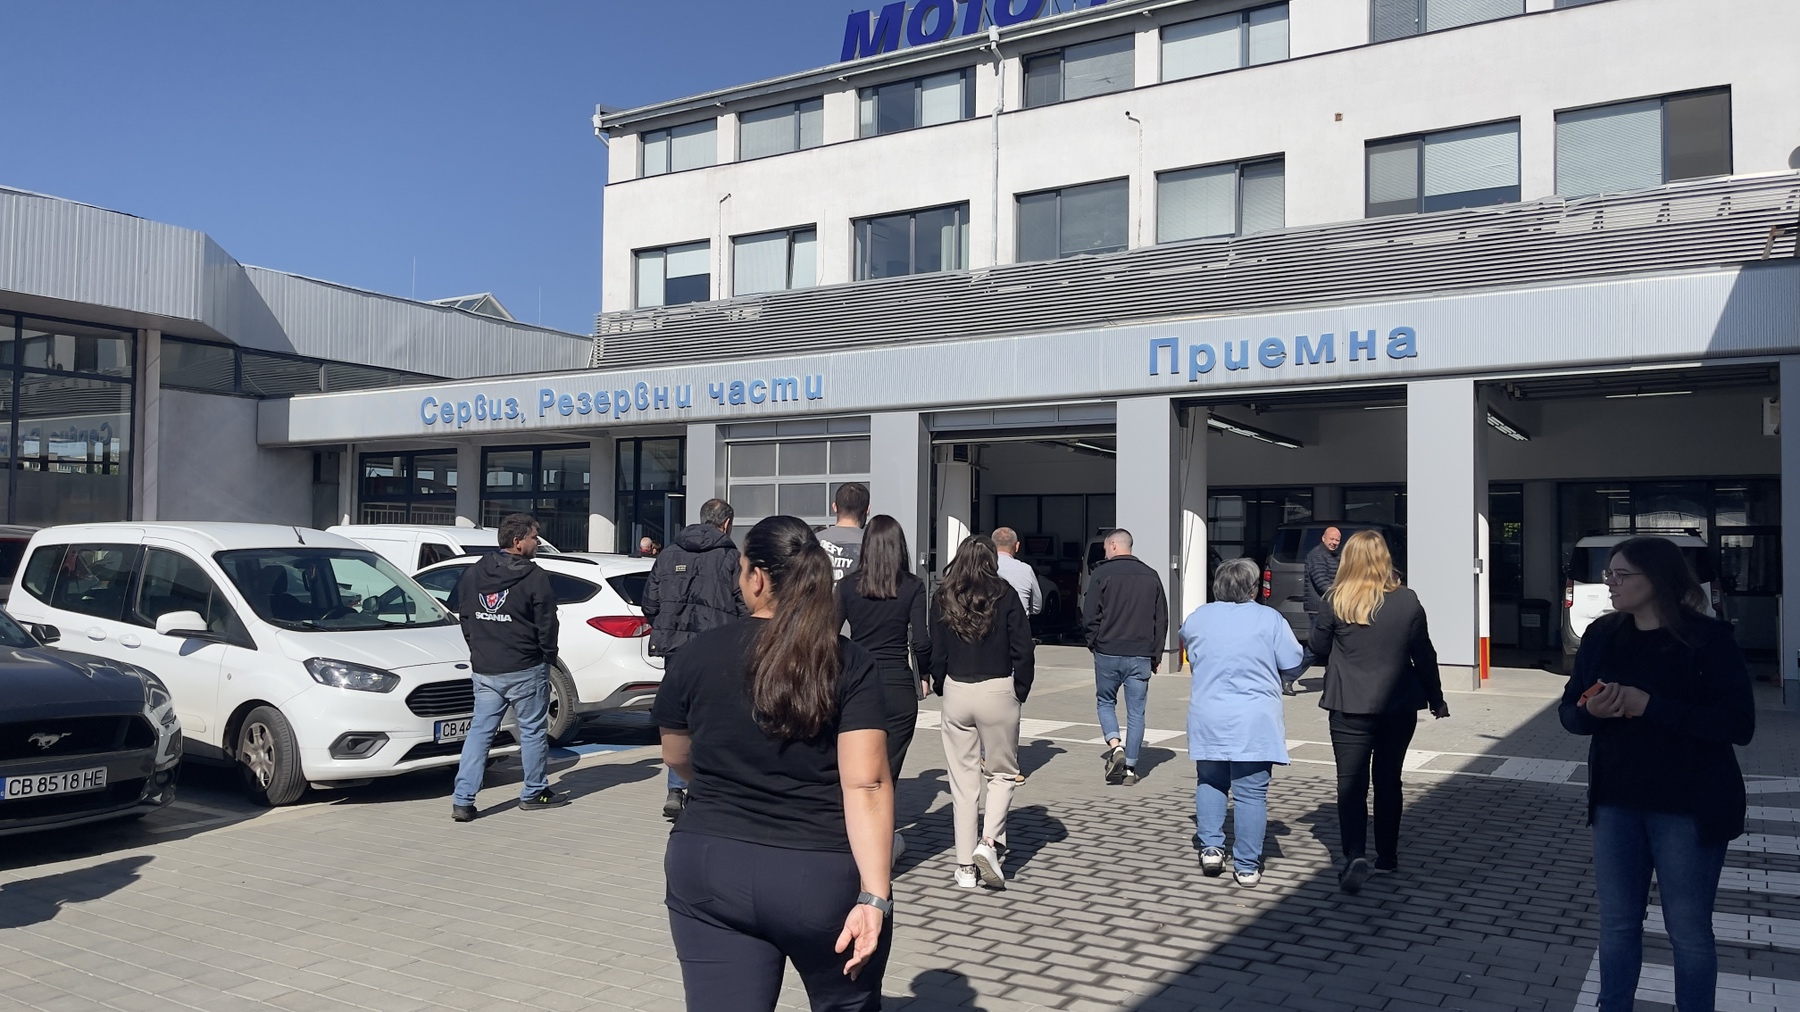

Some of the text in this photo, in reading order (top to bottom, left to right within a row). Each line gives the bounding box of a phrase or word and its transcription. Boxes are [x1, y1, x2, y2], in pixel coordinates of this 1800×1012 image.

[1149, 325, 1418, 382] Приемна
[420, 373, 824, 429] Сервиз, Резервни части
[475, 611, 512, 622] SCANIA
[443, 722, 457, 737] CB
[9, 769, 104, 796] CB 8518 HE
